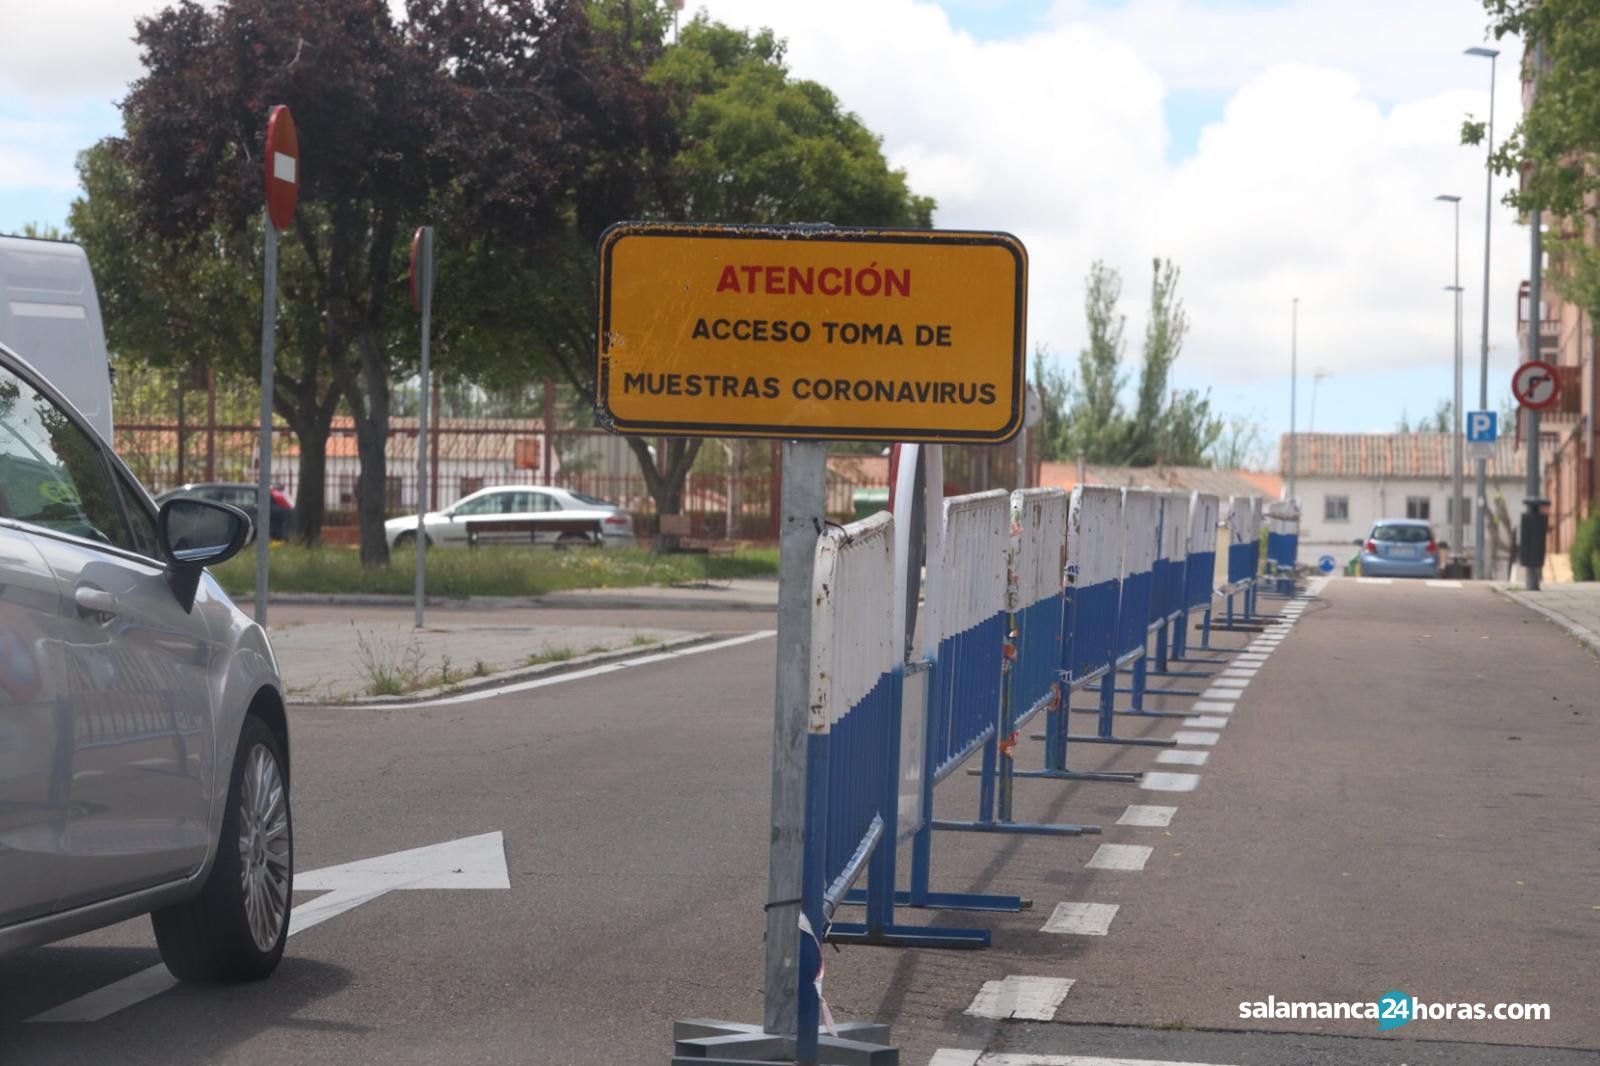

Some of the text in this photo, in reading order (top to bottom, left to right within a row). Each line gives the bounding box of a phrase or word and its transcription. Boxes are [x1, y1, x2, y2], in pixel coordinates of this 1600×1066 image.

[716, 262, 911, 297] ATENCIÓN
[692, 318, 953, 347] ACCESO TOMA DE
[623, 372, 997, 405] MUESTRAS CORONAVIRUS
[1472, 414, 1490, 439] P
